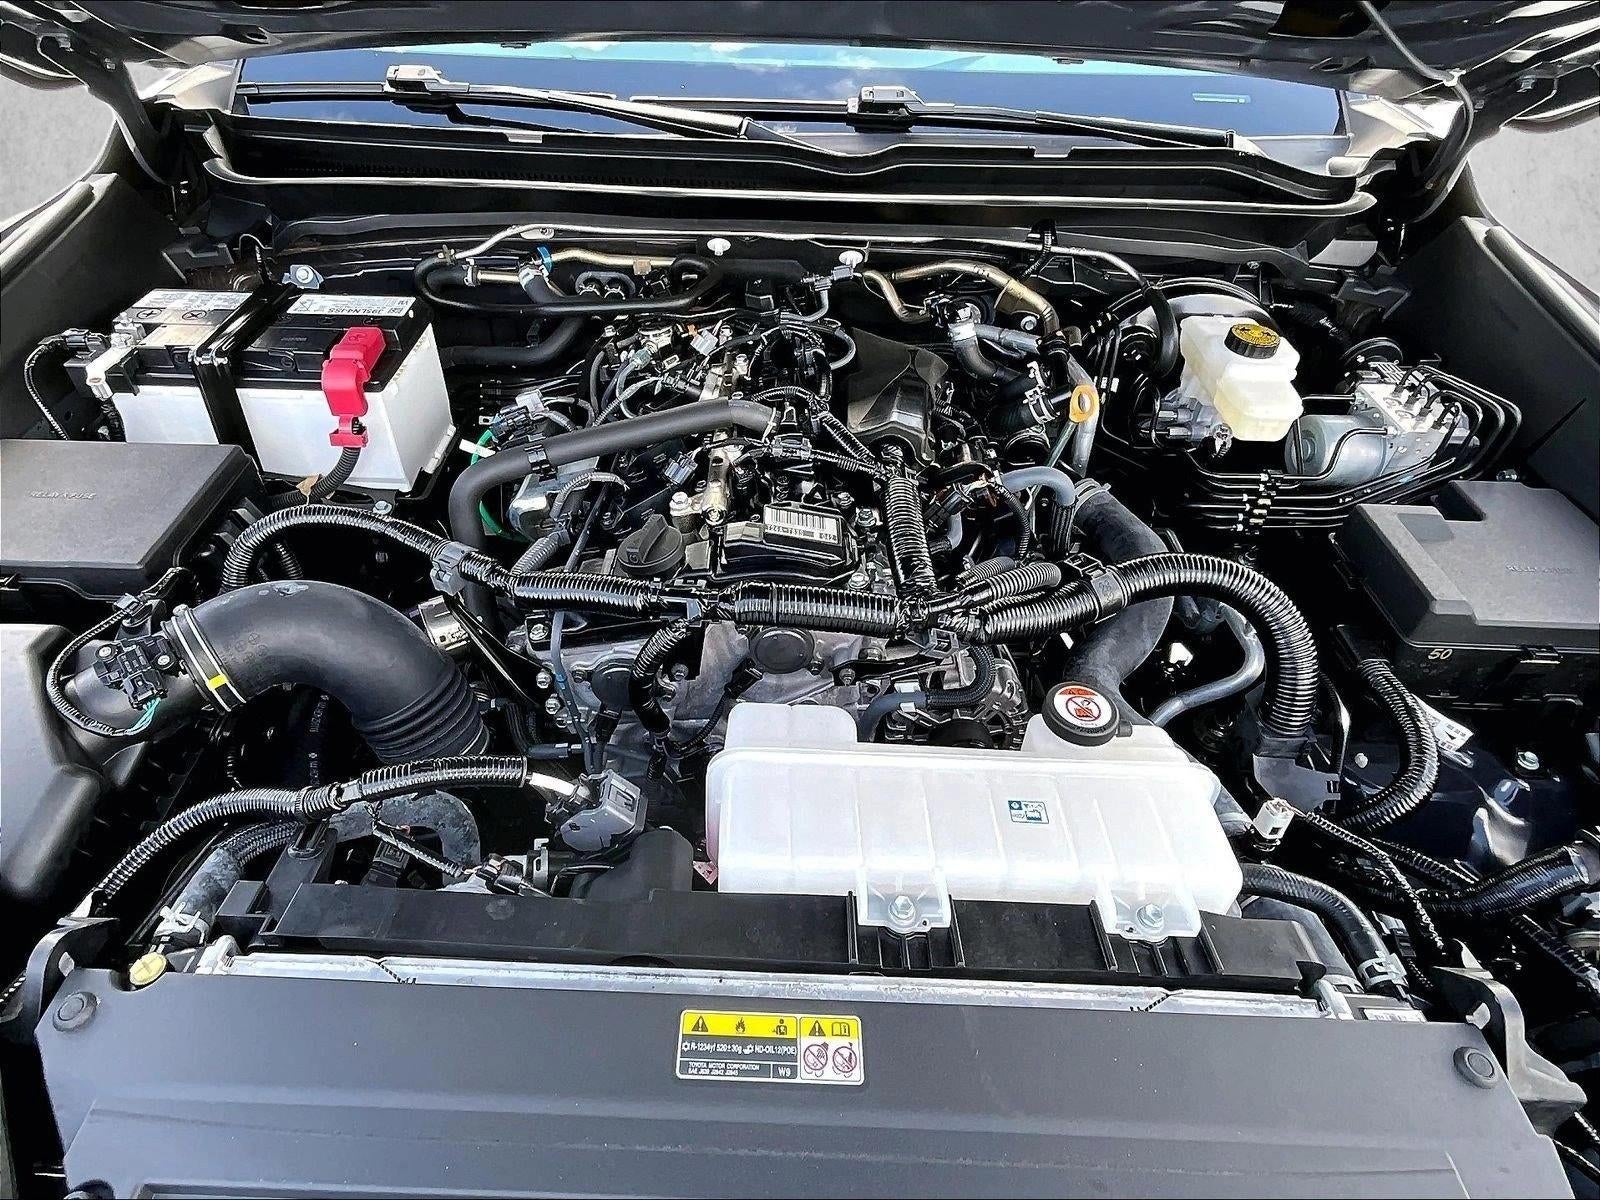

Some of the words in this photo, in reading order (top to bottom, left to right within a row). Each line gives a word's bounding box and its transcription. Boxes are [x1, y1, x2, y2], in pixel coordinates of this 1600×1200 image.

[1428, 648, 1453, 660] 50
[688, 1061, 707, 1069] TOYOTA
[708, 1062, 726, 1070] MOTOR
[726, 1062, 760, 1071] CORPORATION
[777, 1066, 791, 1077] W9
